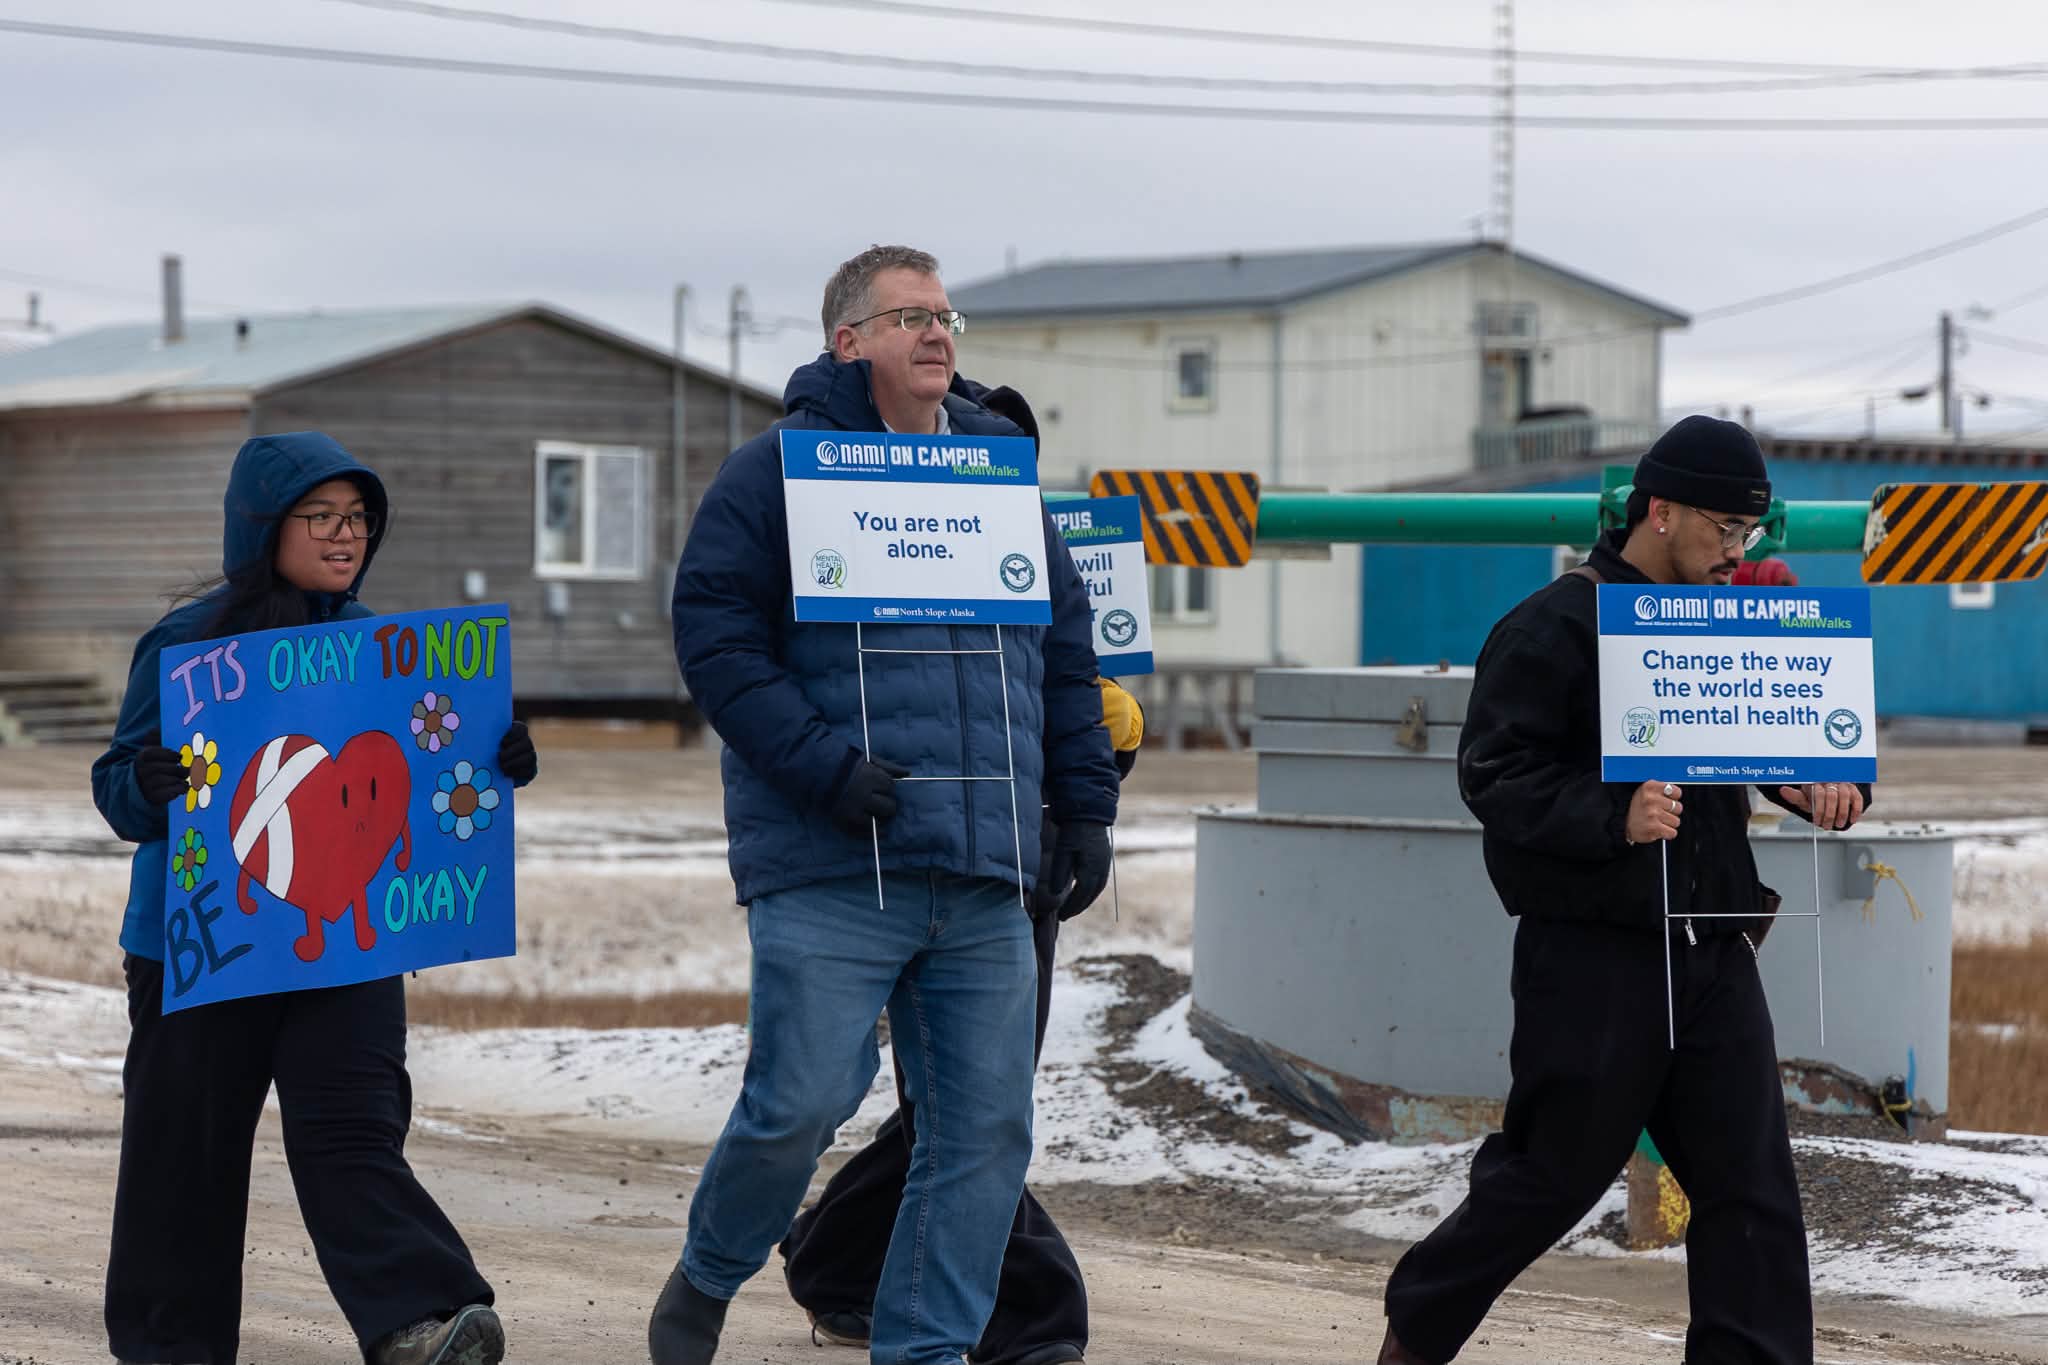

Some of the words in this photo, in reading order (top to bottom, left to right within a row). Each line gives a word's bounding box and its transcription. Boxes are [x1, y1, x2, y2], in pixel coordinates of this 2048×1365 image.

[840, 443, 886, 465] NAMI
[890, 446, 914, 467] ON
[917, 446, 991, 469] CAMPUS
[952, 464, 1020, 478] NAMIWalks
[853, 511, 898, 532] You
[904, 517, 940, 534] are
[946, 515, 982, 534] not
[886, 538, 954, 559] alone.
[1075, 552, 1113, 572] will
[900, 607, 923, 616] North
[924, 607, 947, 619] Slope
[949, 608, 976, 617] Alaska
[1660, 598, 1709, 619] NAMI
[1713, 598, 1739, 620] ON
[1743, 598, 1821, 621] CAMPUS
[1780, 617, 1853, 629] NAMIWalks
[170, 640, 247, 727] ITS
[267, 630, 363, 692] OKAY
[374, 623, 419, 680] TO
[424, 617, 508, 681] NOT
[1642, 649, 1734, 675] Change
[1741, 651, 1778, 671] the
[1785, 655, 1832, 677] way
[1652, 678, 1692, 698] the
[1698, 678, 1764, 699] world
[1770, 681, 1824, 699] sees
[1659, 705, 1739, 725] mental
[1747, 705, 1820, 726] health
[1714, 766, 1740, 775] North
[1741, 766, 1764, 777] Slope
[1766, 766, 1795, 775] Alaska
[384, 863, 488, 934] OKAY
[165, 879, 255, 999] BE
